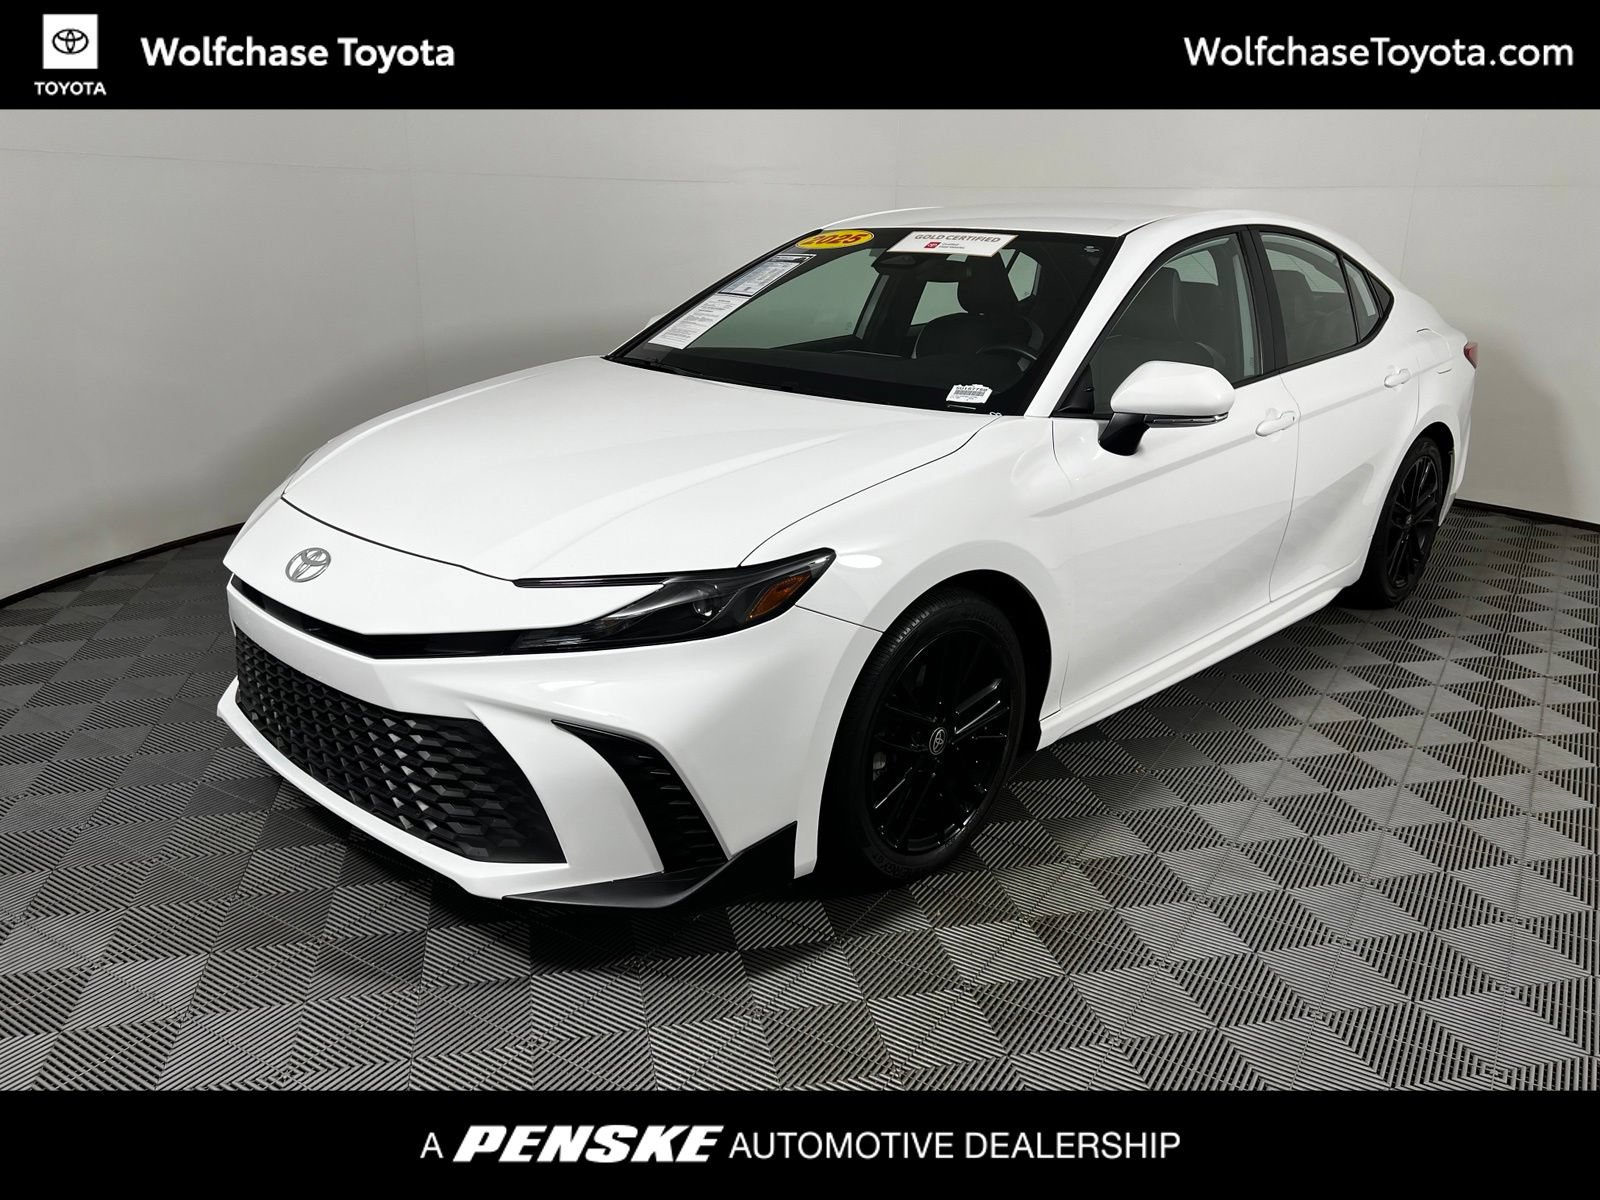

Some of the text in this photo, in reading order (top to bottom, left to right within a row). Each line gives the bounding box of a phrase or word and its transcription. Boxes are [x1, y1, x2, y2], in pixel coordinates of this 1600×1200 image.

[803, 232, 869, 245] 2025
[914, 233, 1001, 243] GOLD CERTIFIED
